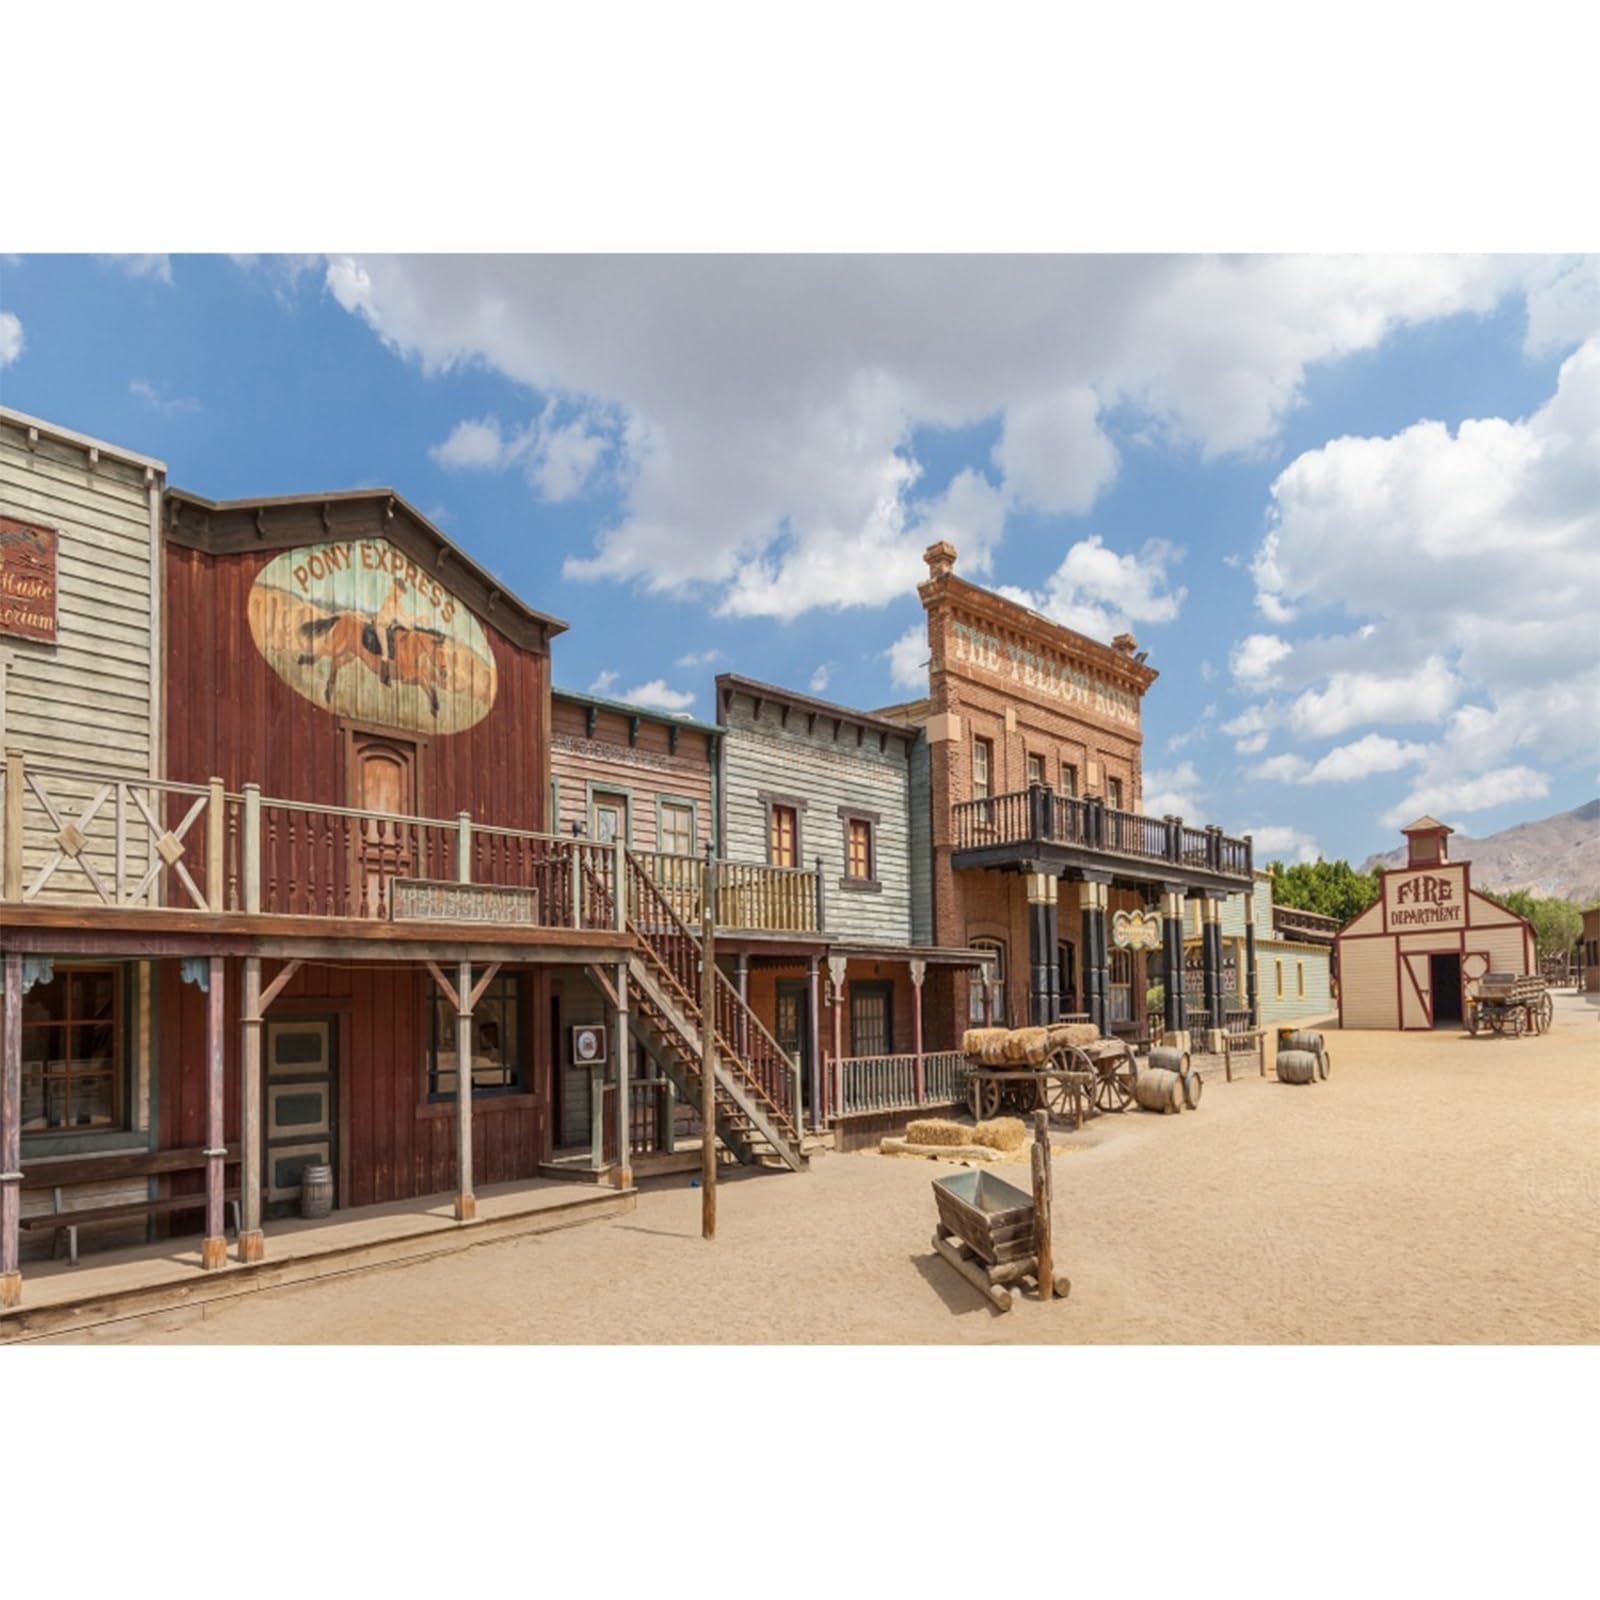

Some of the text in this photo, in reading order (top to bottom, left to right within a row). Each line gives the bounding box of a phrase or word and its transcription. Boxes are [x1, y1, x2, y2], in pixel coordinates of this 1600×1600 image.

[294, 543, 456, 624] PONY EXPRESS
[0, 605, 53, 631] orium
[953, 622, 1137, 726] THE YELLOW ROSE
[397, 886, 532, 922] TELEGRAPH
[1397, 875, 1453, 906] FIRE
[1391, 905, 1461, 925] DEPARTMENT
